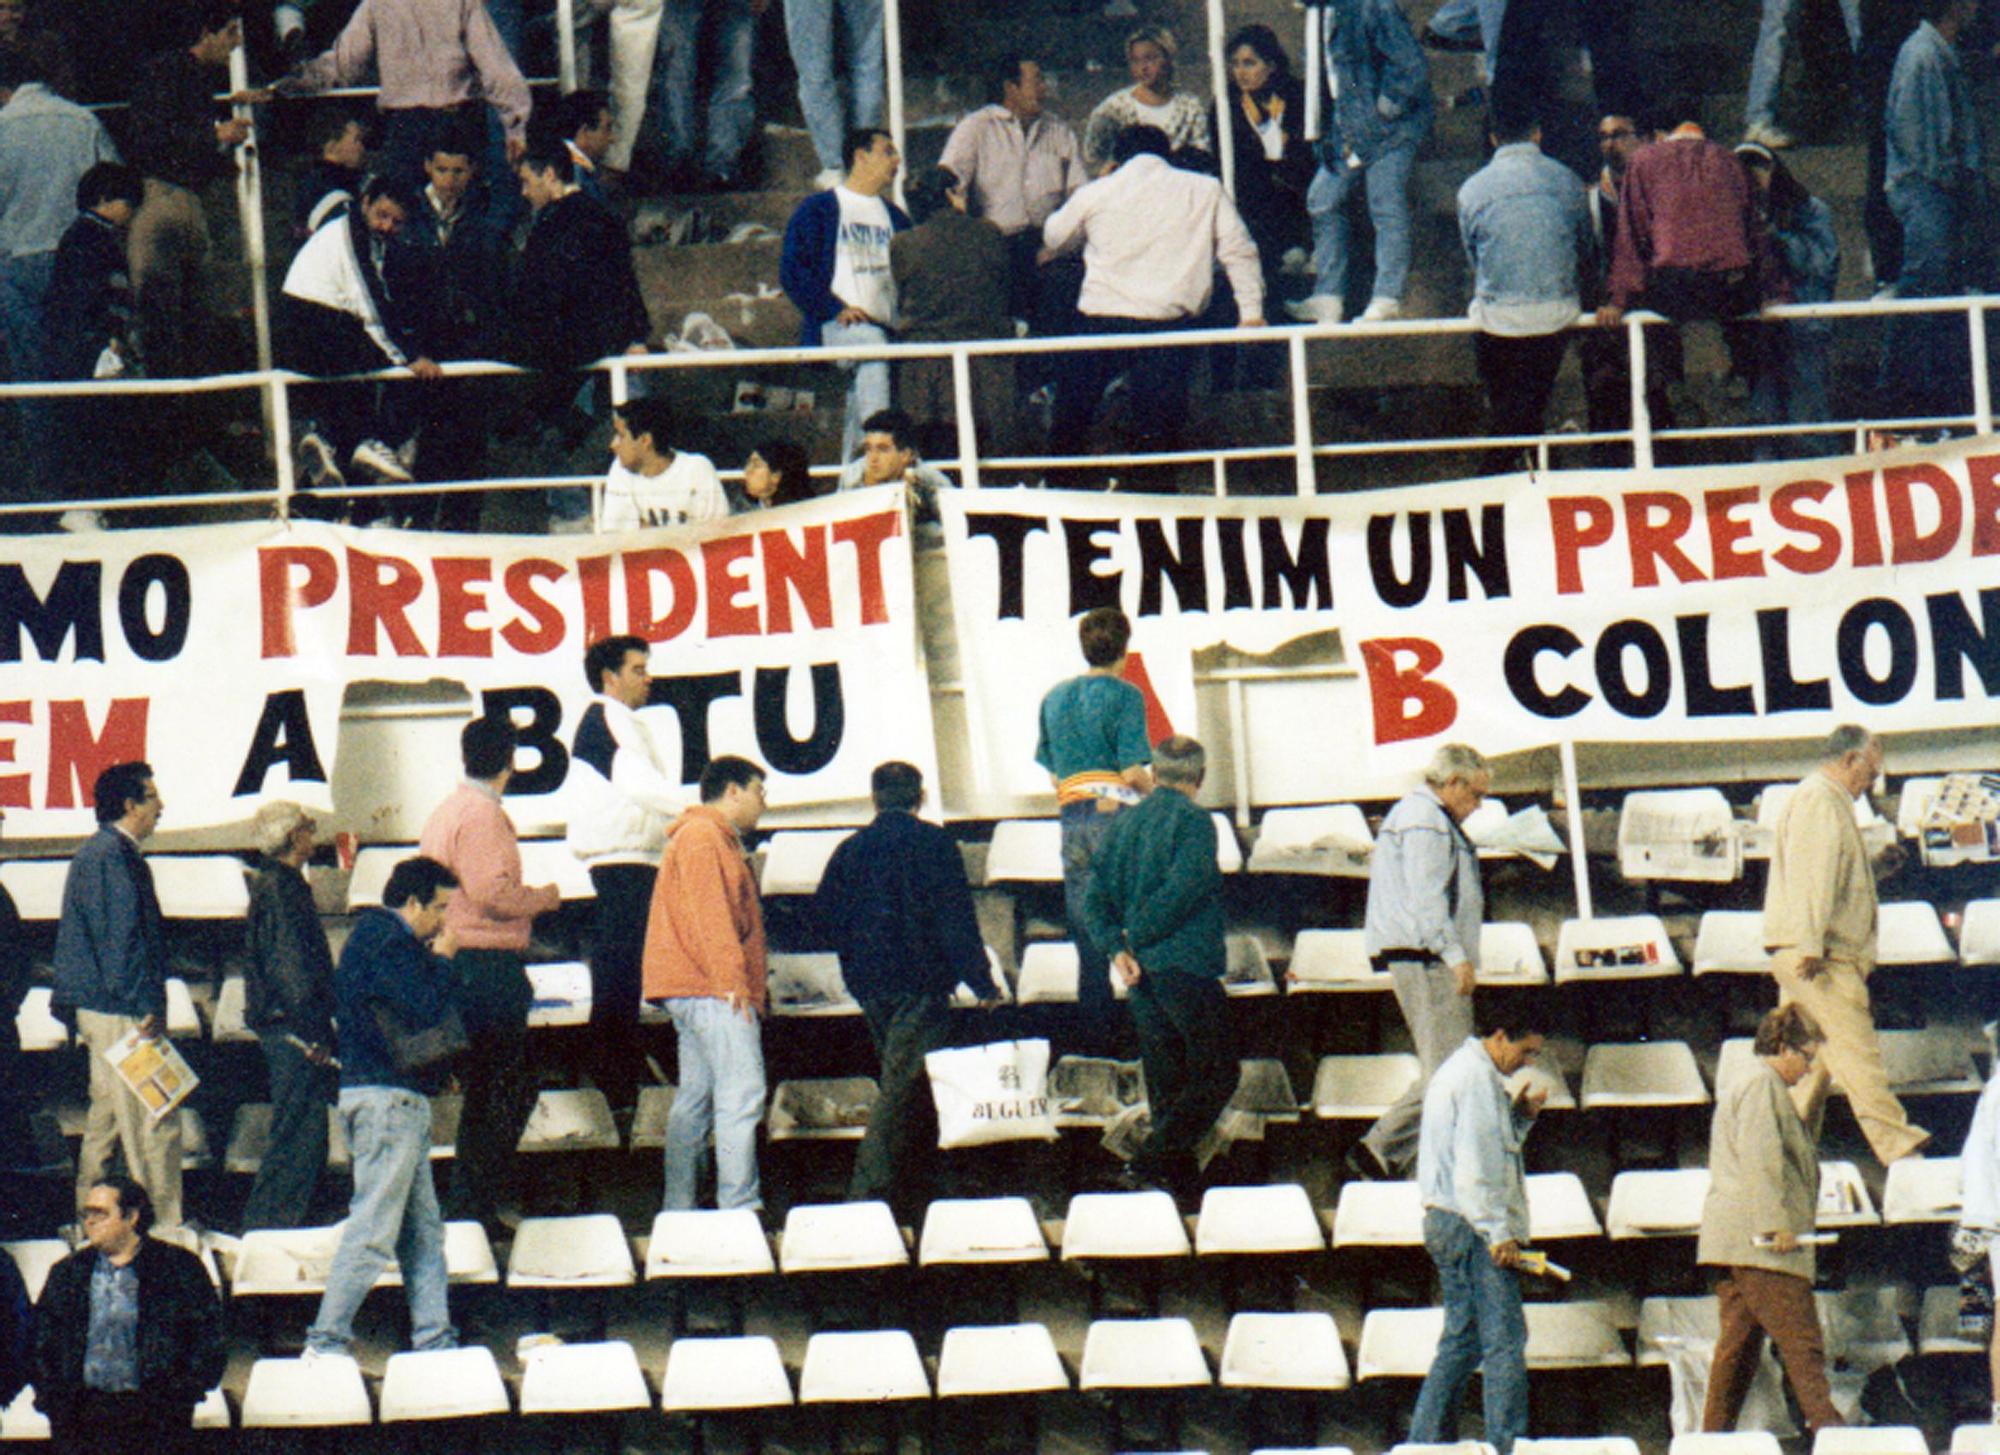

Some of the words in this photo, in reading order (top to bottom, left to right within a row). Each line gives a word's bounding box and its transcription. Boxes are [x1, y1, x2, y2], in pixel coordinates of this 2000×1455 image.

[257, 510, 902, 660] PRESIDENT
[966, 512, 1333, 619] TENIM
[1367, 503, 1511, 608] UN
